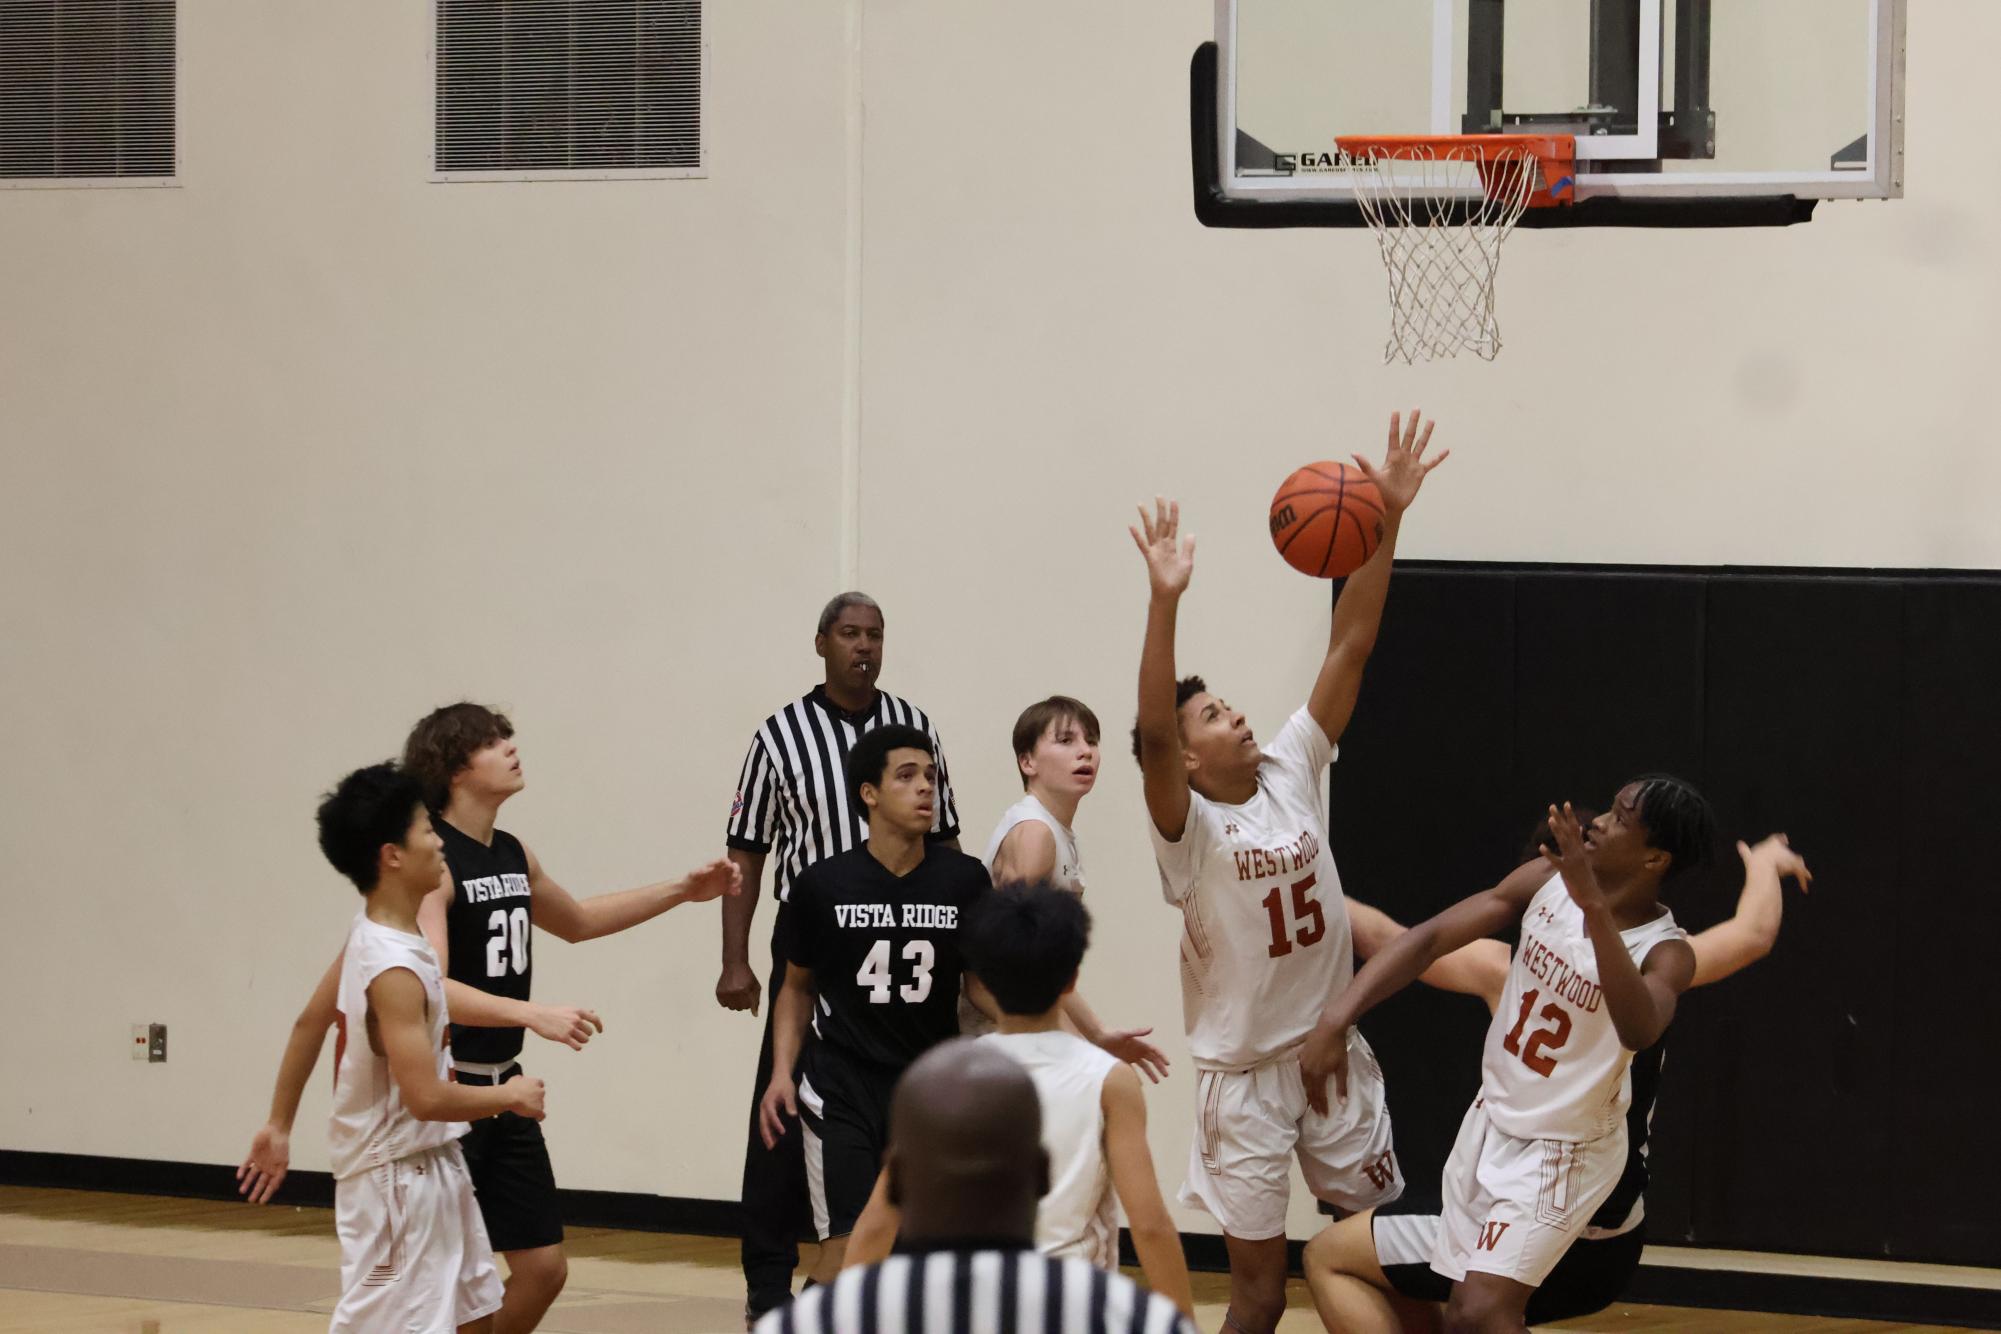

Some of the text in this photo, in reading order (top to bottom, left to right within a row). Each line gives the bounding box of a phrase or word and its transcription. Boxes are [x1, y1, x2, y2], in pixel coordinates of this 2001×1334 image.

[462, 875, 505, 904] VISTA
[834, 903, 959, 929] VISTA RIDGE
[1262, 871, 1326, 959] 15
[486, 907, 530, 978] 20
[856, 939, 935, 1004] 43
[1522, 934, 1602, 1014] WESTWOOD
[1503, 988, 1573, 1079] 12
[1362, 1149, 1395, 1191] W
[1476, 1220, 1510, 1252] W
